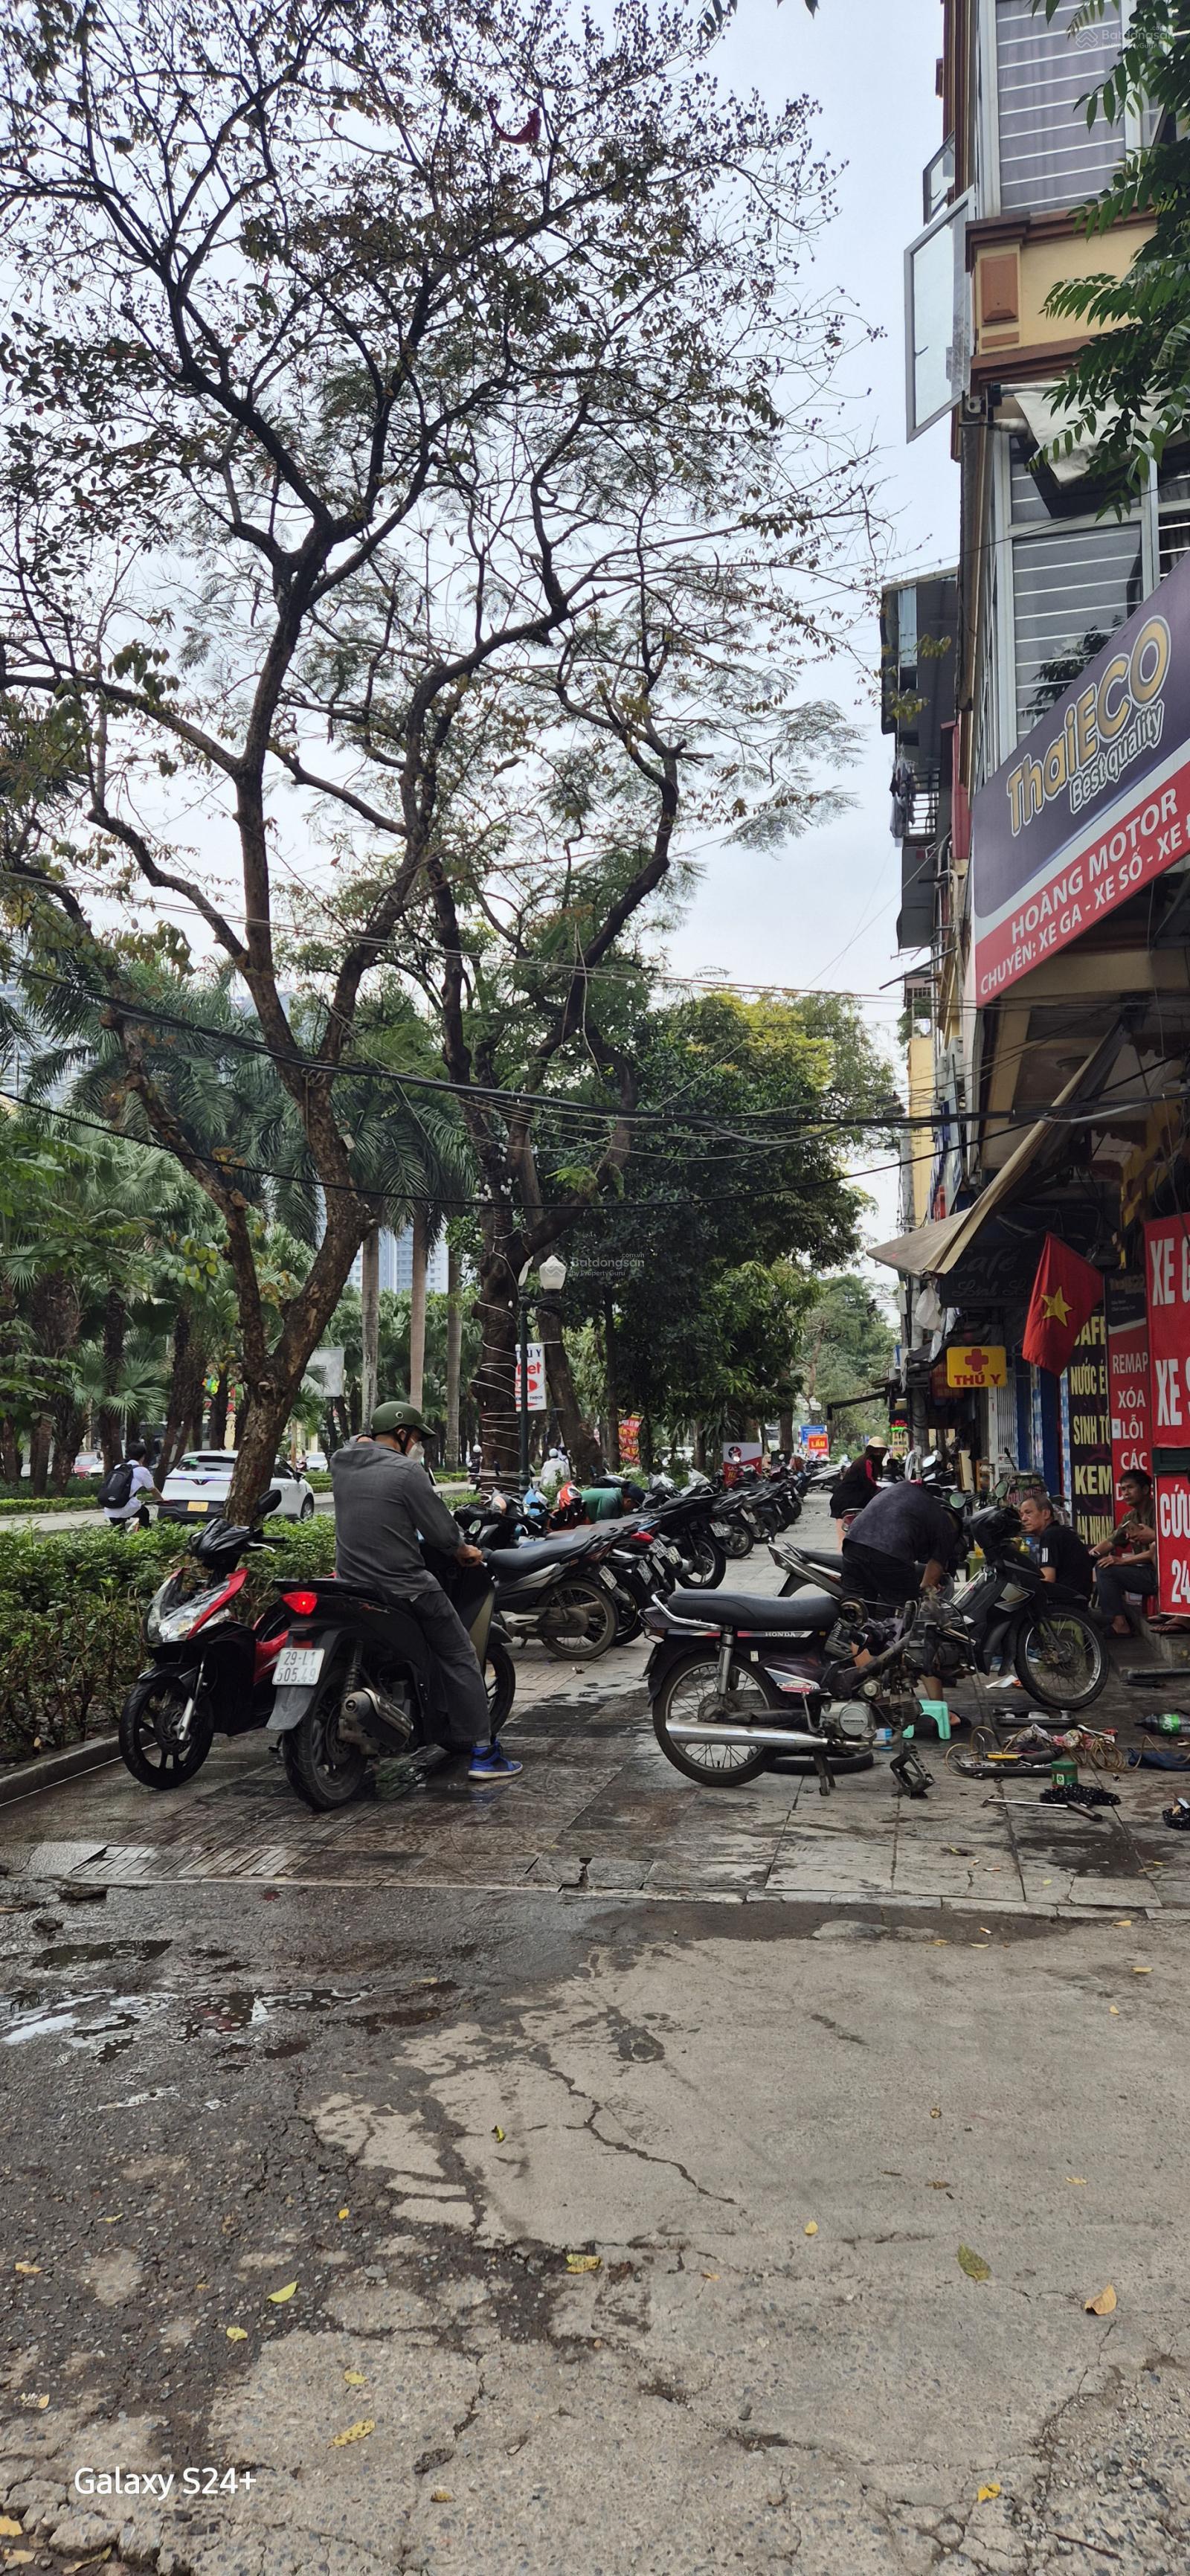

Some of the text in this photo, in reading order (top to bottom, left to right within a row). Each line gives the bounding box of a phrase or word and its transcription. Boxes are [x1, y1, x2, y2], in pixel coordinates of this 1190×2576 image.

[1008, 615, 1171, 837] ThaiECO
[1070, 698, 1165, 815] Best quality
[1012, 788, 1178, 945] HOÀNG MOTOR
[980, 940, 1036, 995] CHUYÊN:
[1039, 921, 1058, 953] XE
[1060, 904, 1082, 934] GA
[1094, 875, 1116, 910] XE
[1119, 846, 1143, 890] SỐ
[1157, 822, 1183, 861] XE
[1150, 1238, 1175, 1306] XE
[1070, 1357, 1097, 1395] NƯỚC
[1113, 1352, 1149, 1374] REMAP
[953, 1372, 1001, 1386] THÚ Y
[1155, 1358, 1183, 1426] XE
[1117, 1387, 1146, 1409] XÓA
[1073, 1415, 1097, 1445] SINH
[1122, 1414, 1144, 1439] LỖI
[1120, 1448, 1148, 1471] CÁC
[1075, 1465, 1113, 1495] KEM
[284, 1651, 316, 1666] 29-L1
